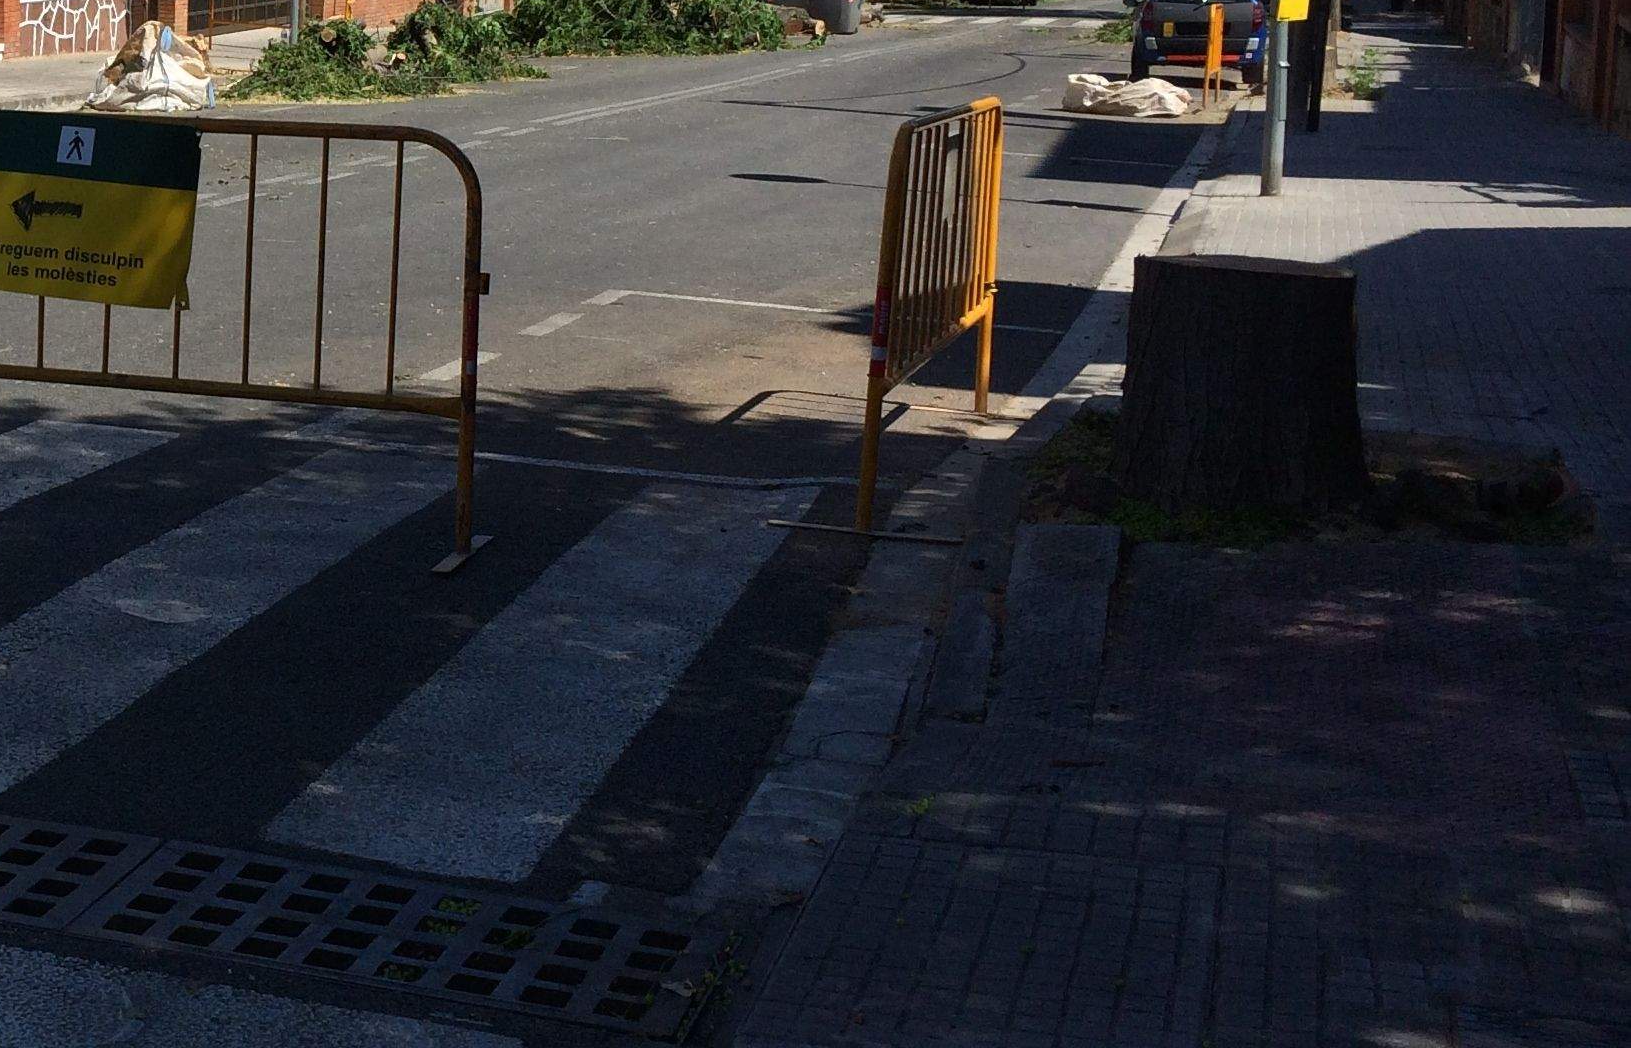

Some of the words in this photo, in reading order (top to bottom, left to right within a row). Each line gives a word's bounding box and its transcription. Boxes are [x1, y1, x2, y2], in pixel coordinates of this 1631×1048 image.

[64, 247, 144, 270] disculpin
[7, 262, 30, 278] les
[34, 264, 117, 287] molèsties
